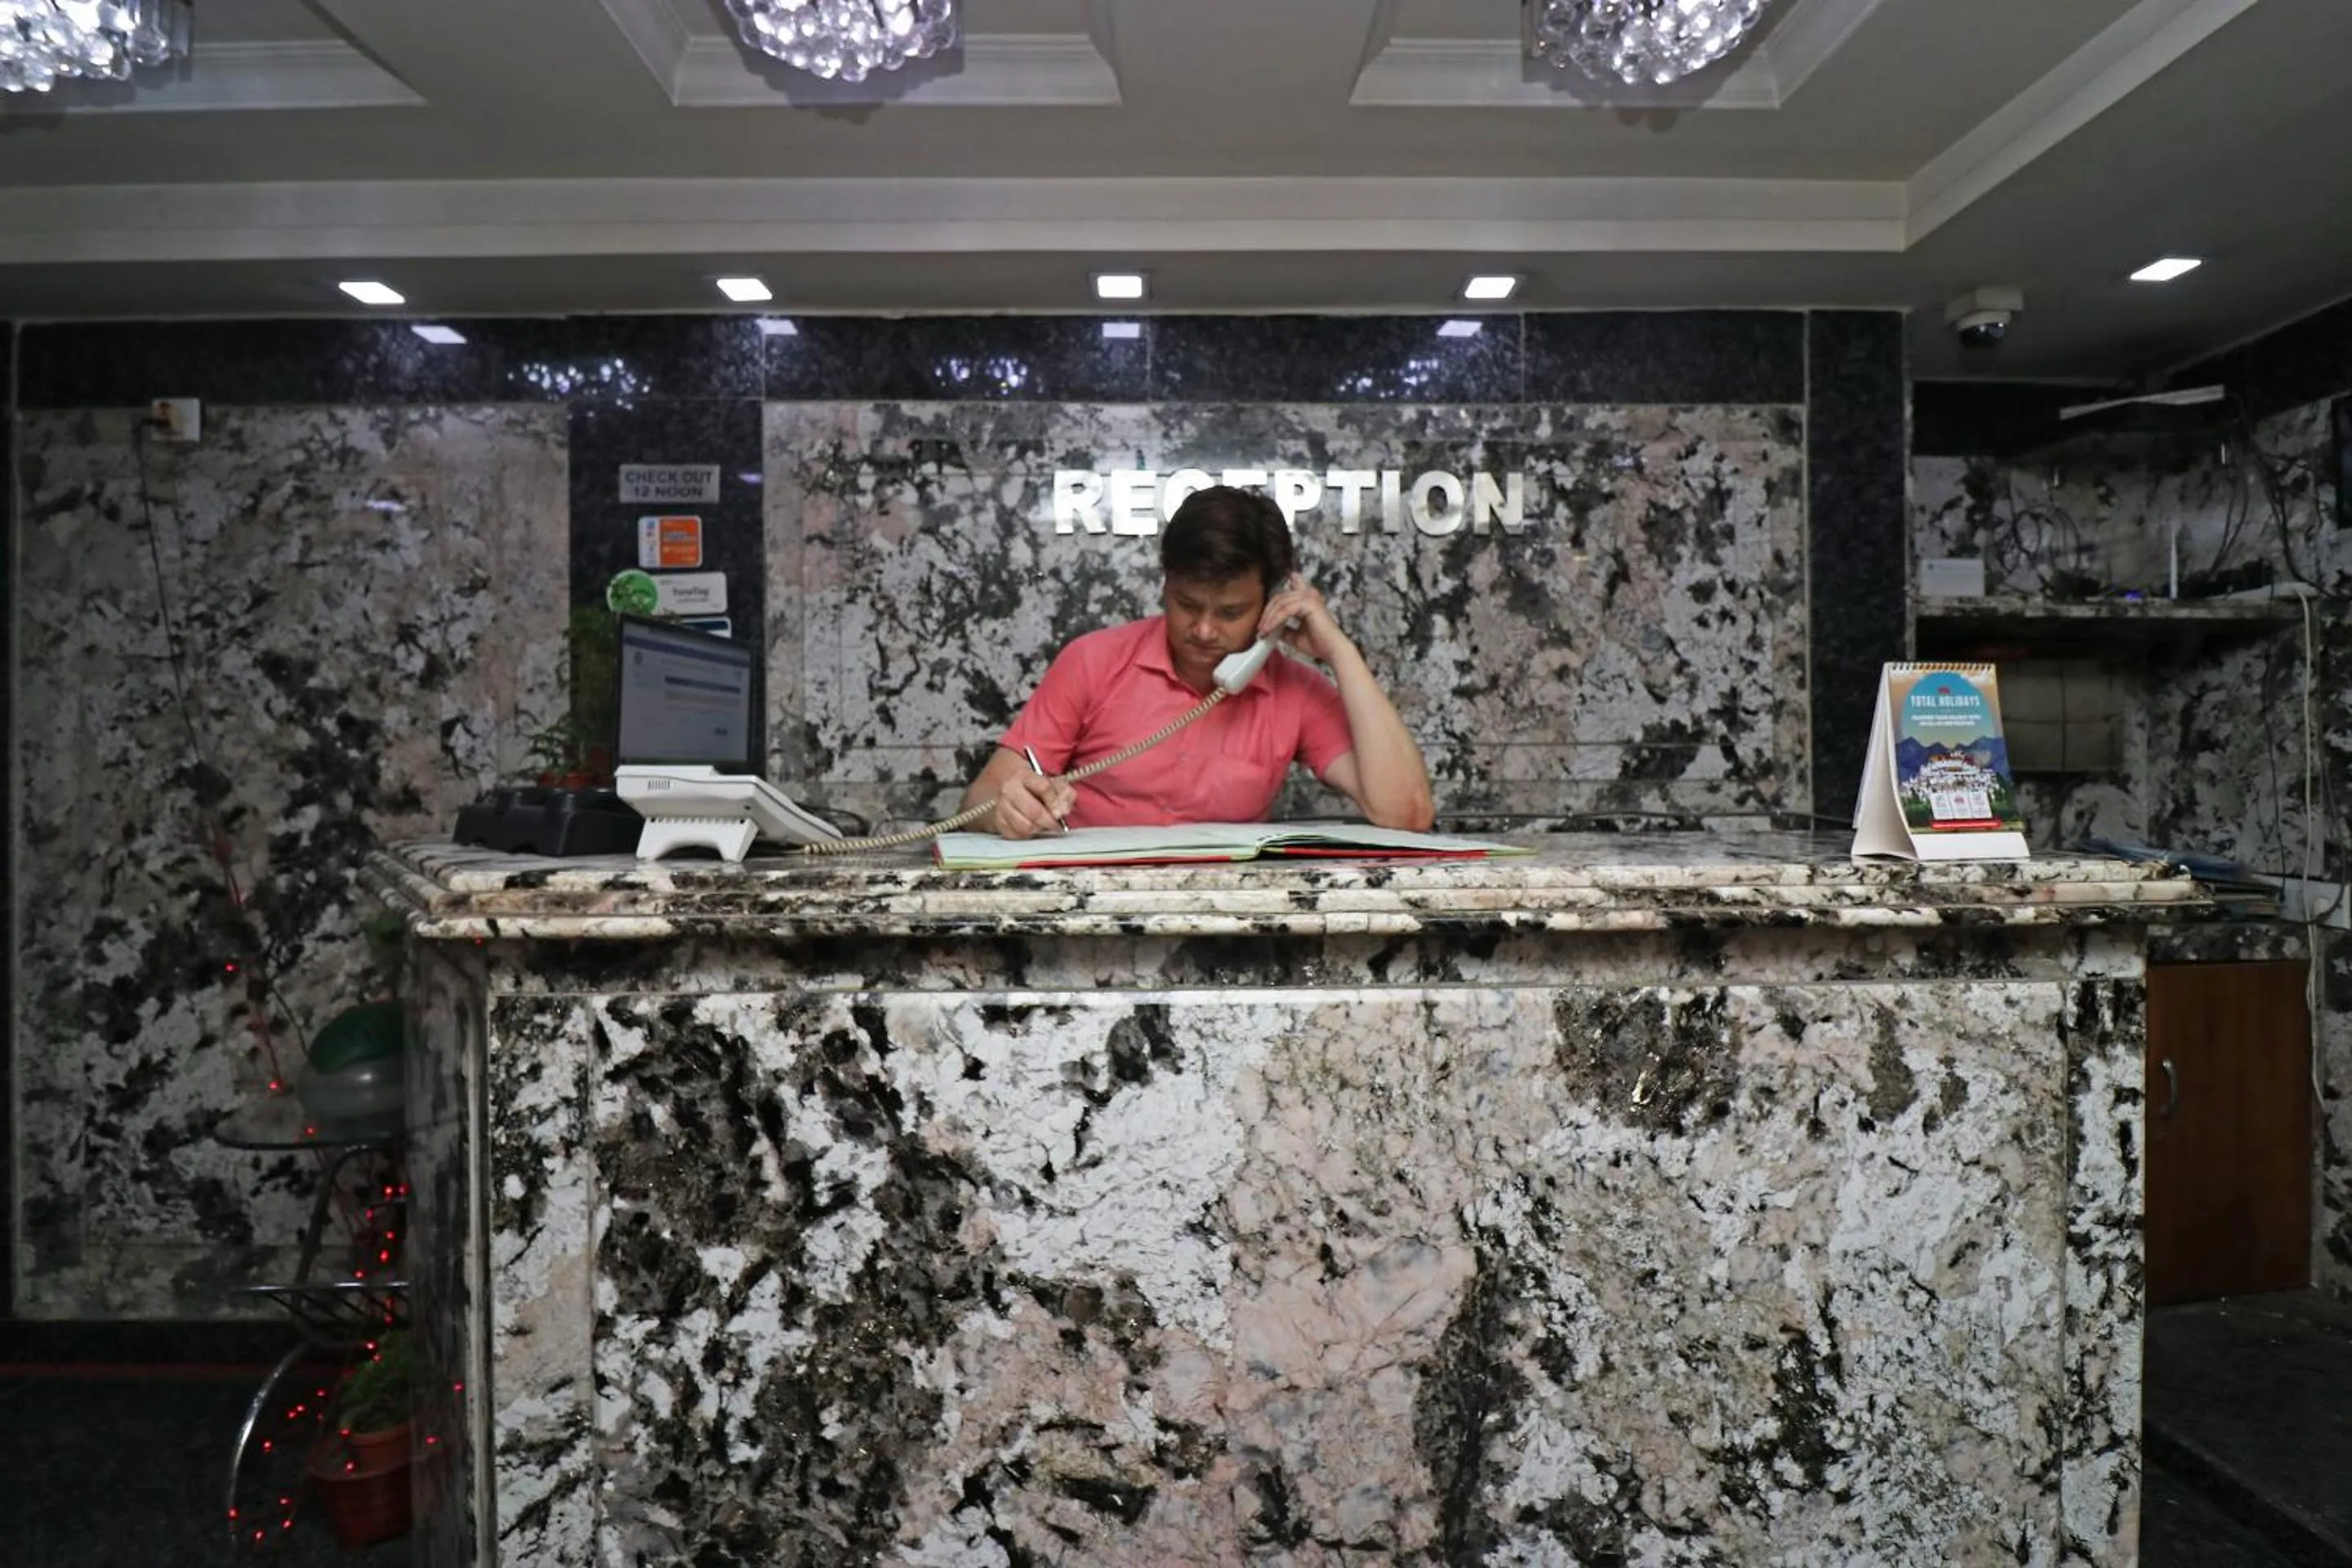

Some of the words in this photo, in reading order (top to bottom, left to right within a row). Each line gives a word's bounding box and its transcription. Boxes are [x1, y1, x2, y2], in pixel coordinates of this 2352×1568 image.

[625, 470, 677, 483] CHECK
[681, 470, 713, 483] OUT
[634, 487, 649, 497] 12
[655, 487, 702, 497] NOON
[1054, 468, 1524, 536] RECPTION
[1911, 695, 1936, 707] TOTAL
[1939, 695, 1980, 707] HOLIDAYS
